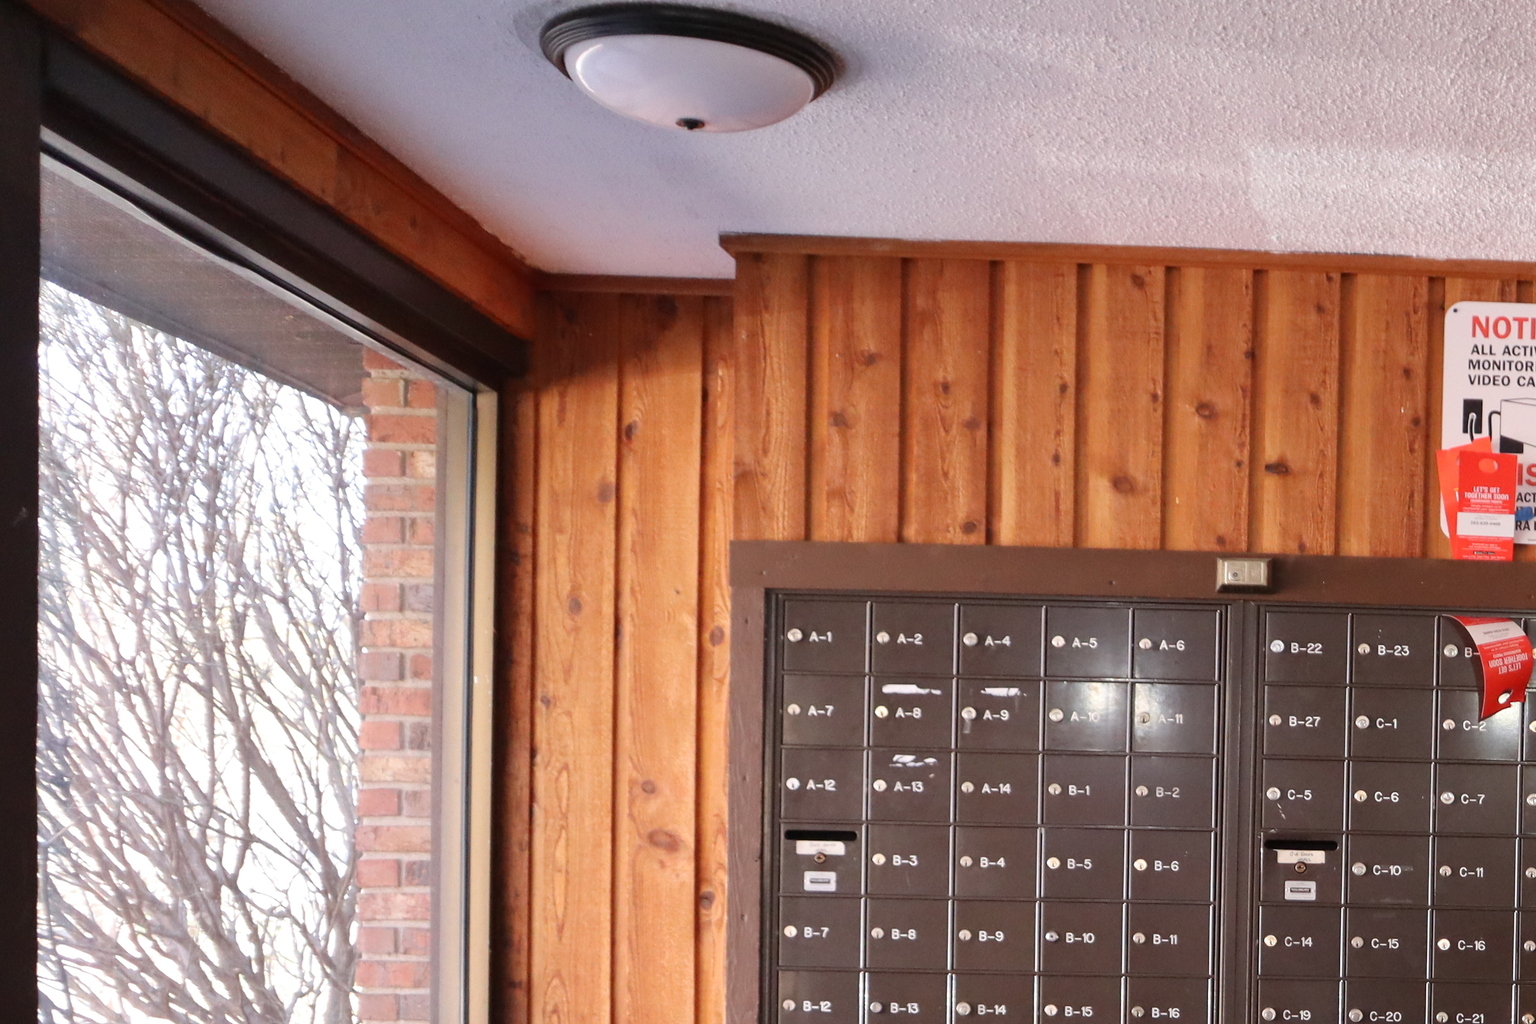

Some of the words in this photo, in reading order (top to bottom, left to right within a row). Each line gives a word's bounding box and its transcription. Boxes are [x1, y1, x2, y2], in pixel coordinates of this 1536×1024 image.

[1471, 344, 1496, 356] ALL
[1468, 374, 1511, 387] VIDEO
[1515, 520, 1530, 531] RA
[810, 632, 831, 642] A-1
[897, 633, 922, 644] A-2
[985, 636, 1010, 646] A-4
[1072, 638, 1097, 648] A-5
[1160, 640, 1184, 650] A-6
[1291, 643, 1322, 653] B-22
[1378, 645, 1409, 656] B-23
[1464, 647, 1480, 657] B-
[808, 706, 833, 716] A-7
[896, 707, 921, 718] A-8
[983, 710, 1009, 720] A-9
[1289, 716, 1320, 727] B-27
[1377, 718, 1397, 728] C-1
[1463, 719, 1486, 731] C-2
[807, 780, 835, 790] A-12
[894, 782, 923, 792] A-13
[982, 783, 1011, 794] A-14
[1069, 785, 1089, 795] B-1
[1156, 787, 1179, 797] B-2
[1288, 790, 1312, 800] C-5
[1375, 792, 1399, 802] C-6
[1461, 794, 1485, 804] C-7
[893, 855, 917, 866] B-3
[980, 857, 1005, 867] B-4
[1068, 859, 1092, 869] B-5
[1155, 861, 1179, 871] B-6
[1373, 865, 1401, 875] C-10
[1460, 867, 1483, 877] C-11
[804, 927, 829, 938] B-7
[892, 929, 916, 939] B-8
[979, 931, 1004, 941] B-9
[1066, 933, 1094, 943] B-10
[1153, 934, 1177, 944] B-11
[1285, 937, 1312, 947] C-14
[1372, 938, 1399, 949] C-15
[1458, 940, 1485, 950] C-16
[803, 1001, 831, 1012] B-12
[891, 1003, 919, 1013] B-13
[978, 1005, 1006, 1015] B-14
[1065, 1006, 1092, 1017] B-15
[1152, 1008, 1179, 1018] B-16
[1283, 1010, 1311, 1020] C-19
[1370, 1011, 1401, 1022] C-20
[1457, 1013, 1483, 1023] C-21
